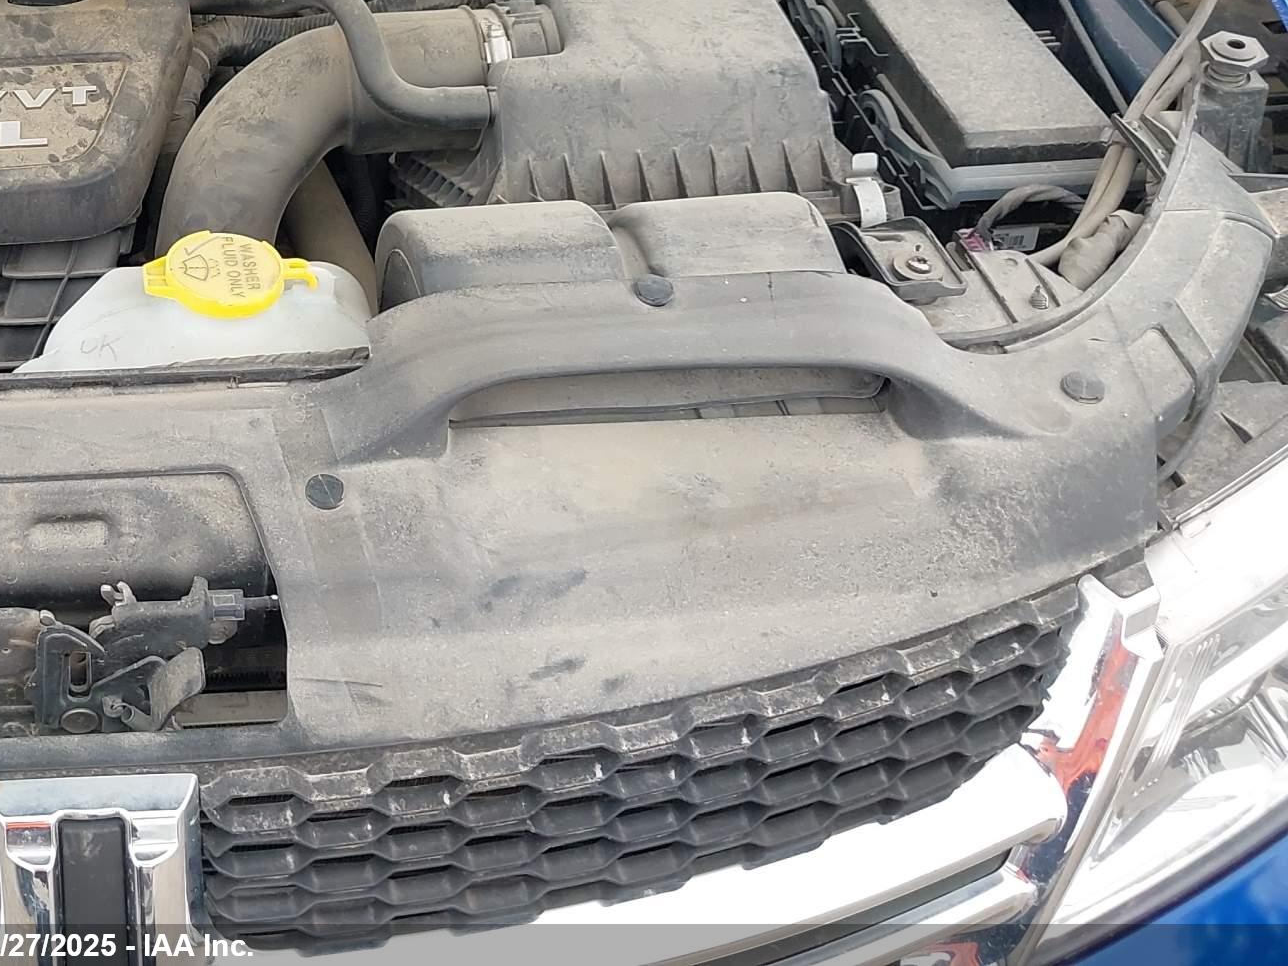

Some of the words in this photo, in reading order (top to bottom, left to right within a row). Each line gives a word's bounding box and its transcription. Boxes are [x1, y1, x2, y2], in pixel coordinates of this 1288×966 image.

[221, 236, 239, 267] FLUID
[239, 243, 261, 290] WASHER
[226, 270, 246, 298] ONLY
